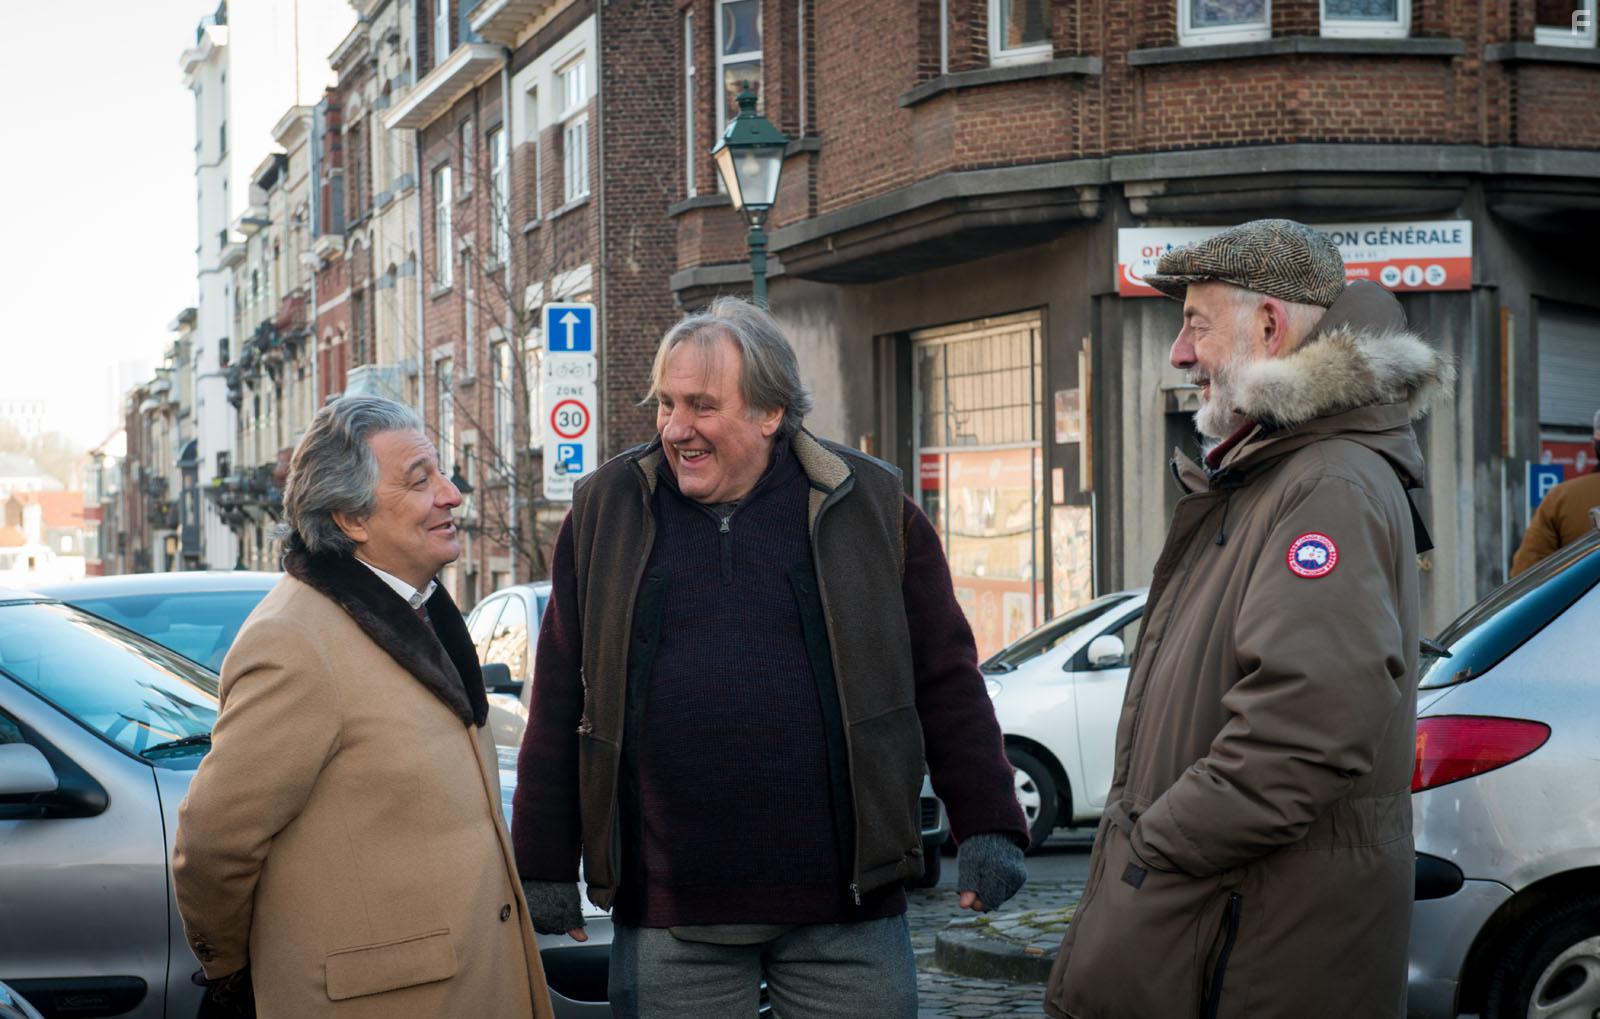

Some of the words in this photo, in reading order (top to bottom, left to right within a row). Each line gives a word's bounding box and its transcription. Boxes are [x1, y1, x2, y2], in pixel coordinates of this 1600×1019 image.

[1364, 226, 1463, 246] GÉNÉRALE
[557, 386, 583, 396] ZONE
[559, 411, 582, 427] 30
[560, 446, 575, 462] P
[1539, 473, 1558, 498] P
